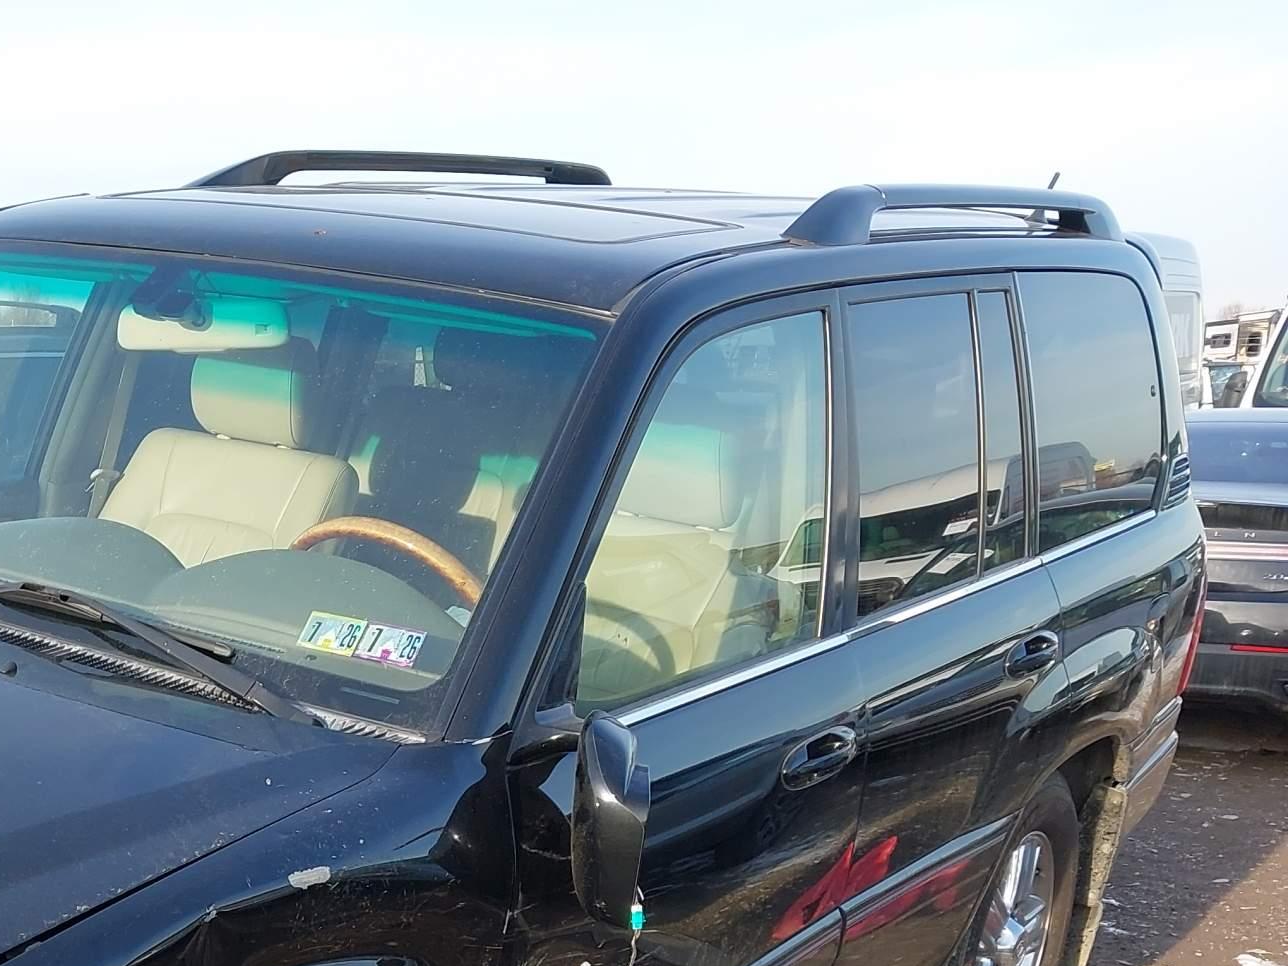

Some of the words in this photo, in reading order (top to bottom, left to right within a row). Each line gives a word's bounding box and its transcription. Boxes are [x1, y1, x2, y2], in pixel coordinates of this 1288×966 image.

[306, 621, 323, 643] 7
[339, 623, 362, 649] 26
[367, 627, 384, 653] 7
[399, 634, 421, 660] 26
